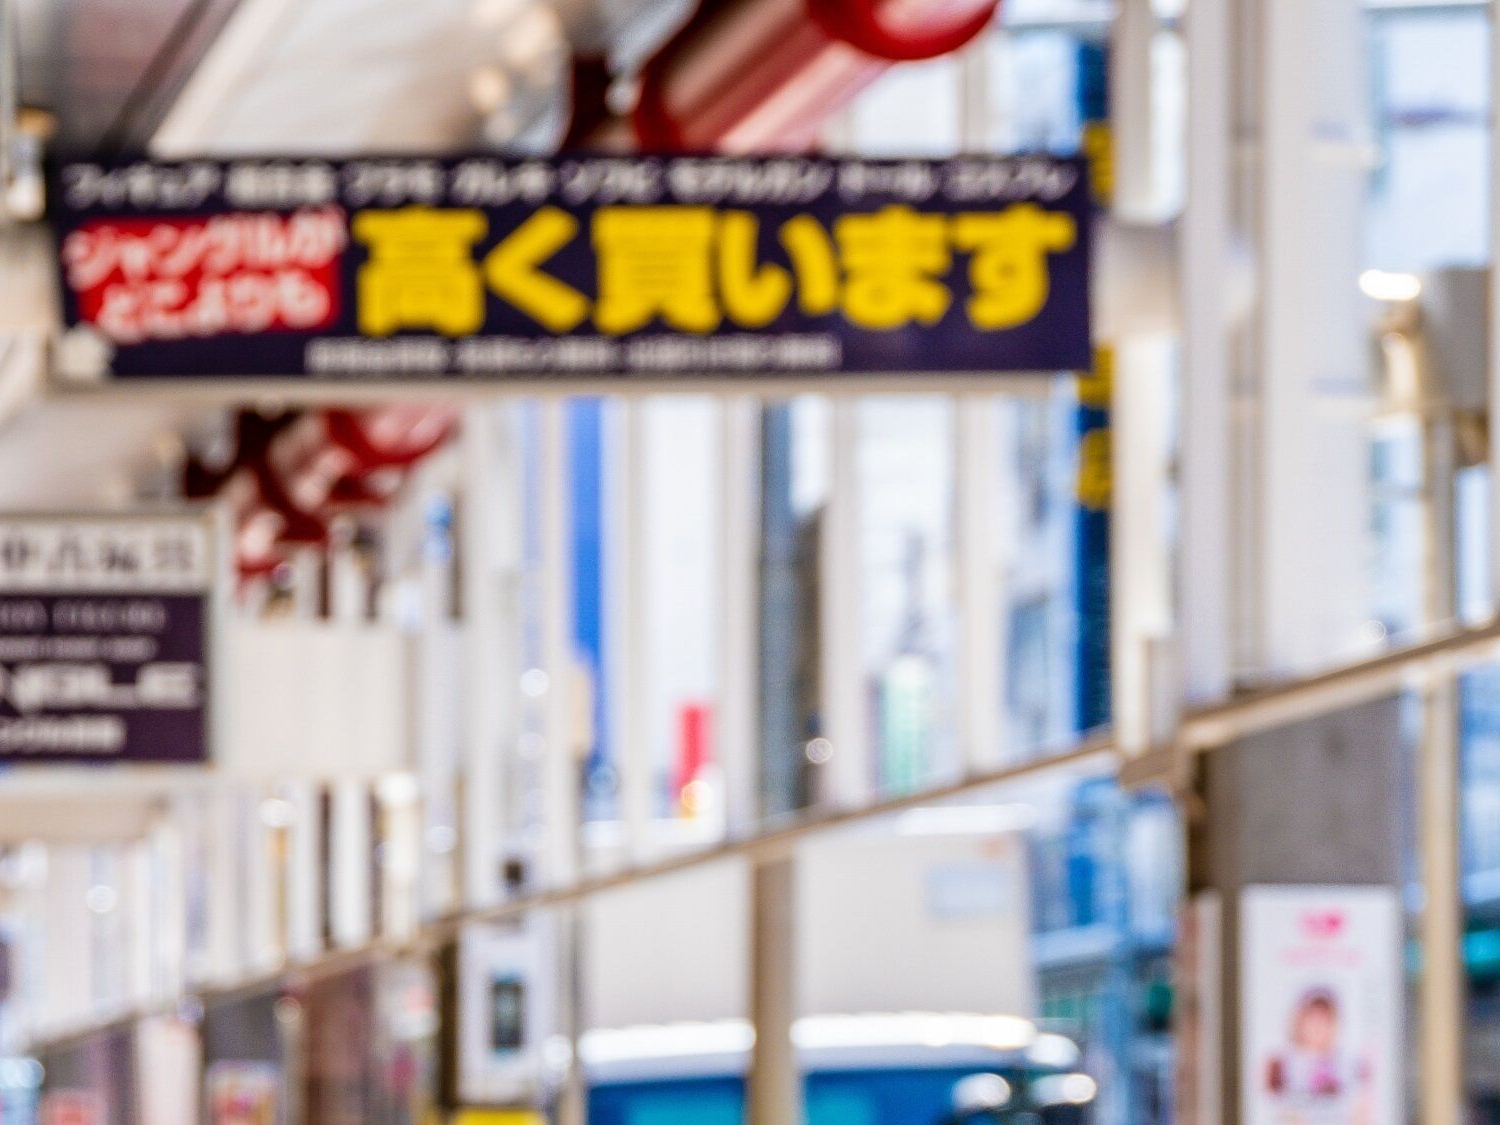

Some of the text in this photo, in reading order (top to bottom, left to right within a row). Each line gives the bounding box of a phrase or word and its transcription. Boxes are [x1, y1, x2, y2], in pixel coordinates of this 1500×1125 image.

[354, 206, 1076, 336] 高く買います
